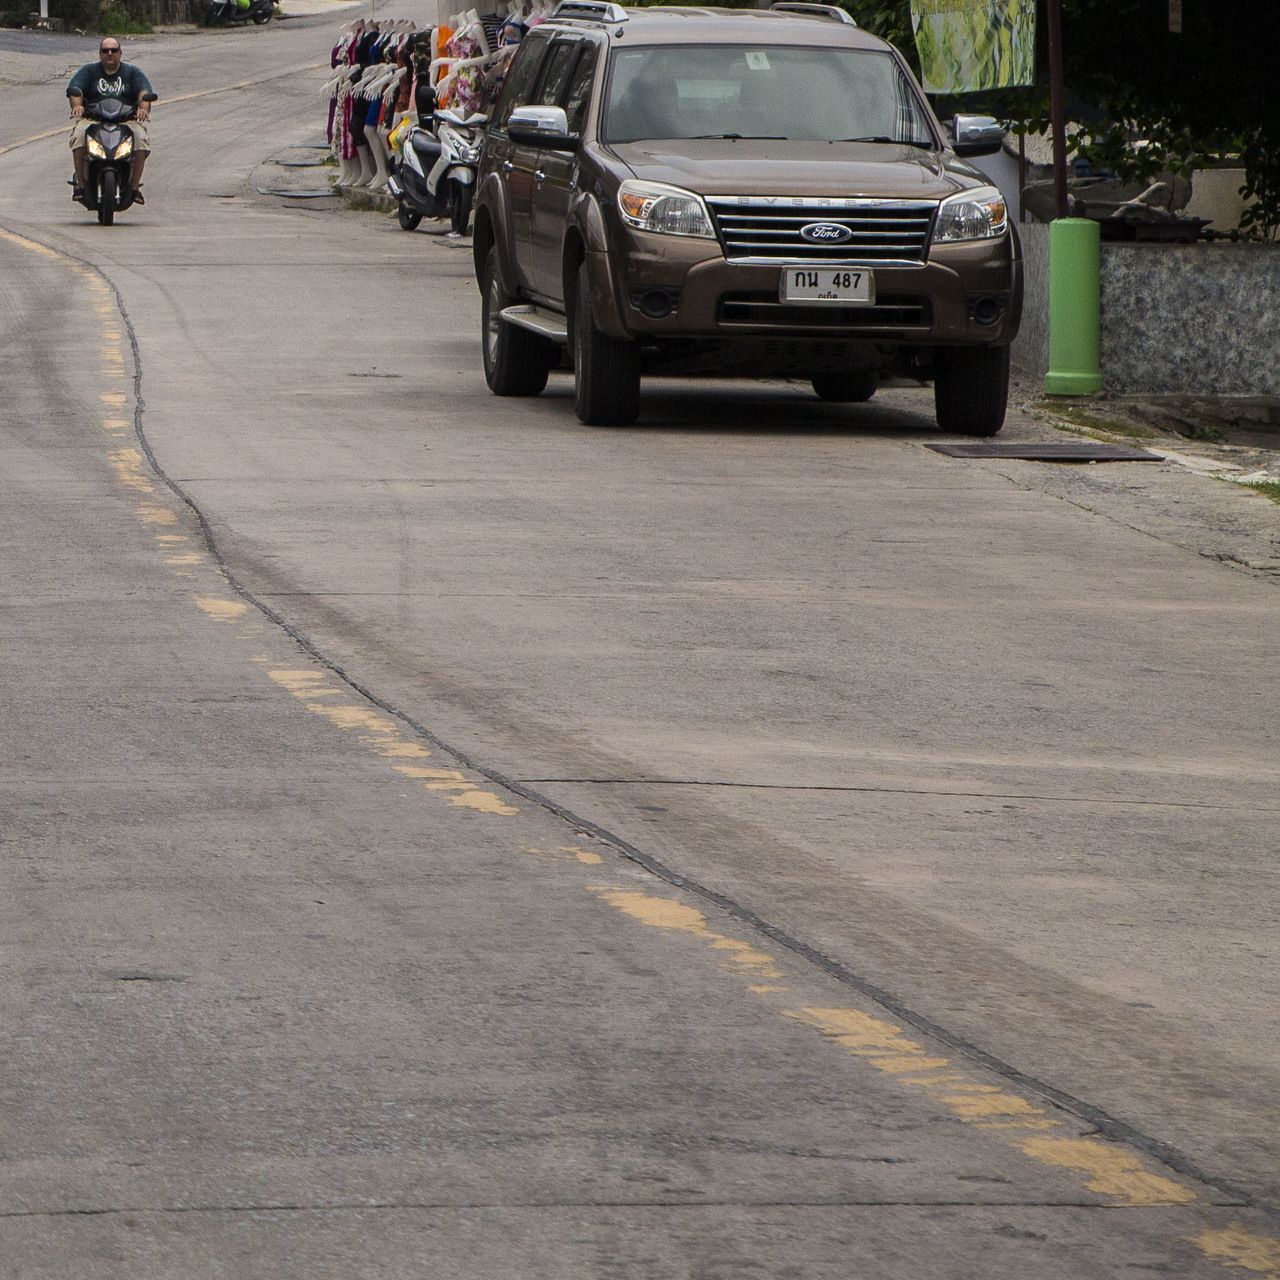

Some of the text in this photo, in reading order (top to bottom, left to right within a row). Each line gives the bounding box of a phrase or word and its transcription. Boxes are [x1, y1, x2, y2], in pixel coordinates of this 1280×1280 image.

[811, 225, 841, 240] Ford
[794, 271, 862, 289] กน 487
